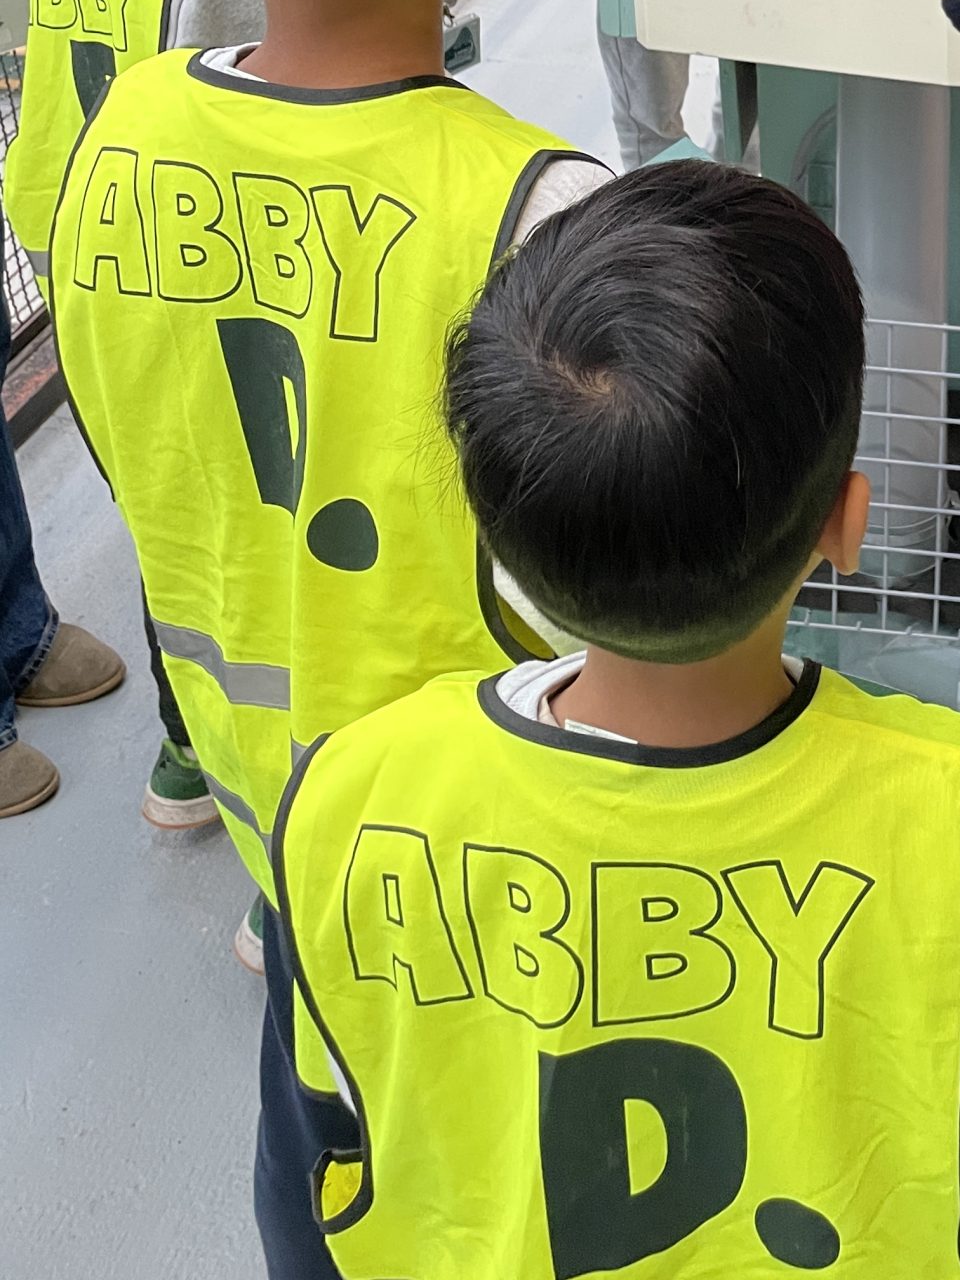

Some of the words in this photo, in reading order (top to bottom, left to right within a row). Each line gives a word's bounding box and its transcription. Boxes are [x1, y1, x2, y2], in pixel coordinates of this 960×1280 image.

[74, 146, 417, 342] ABBY
[342, 822, 876, 1040] ABBY
[537, 1036, 841, 1280] D.
